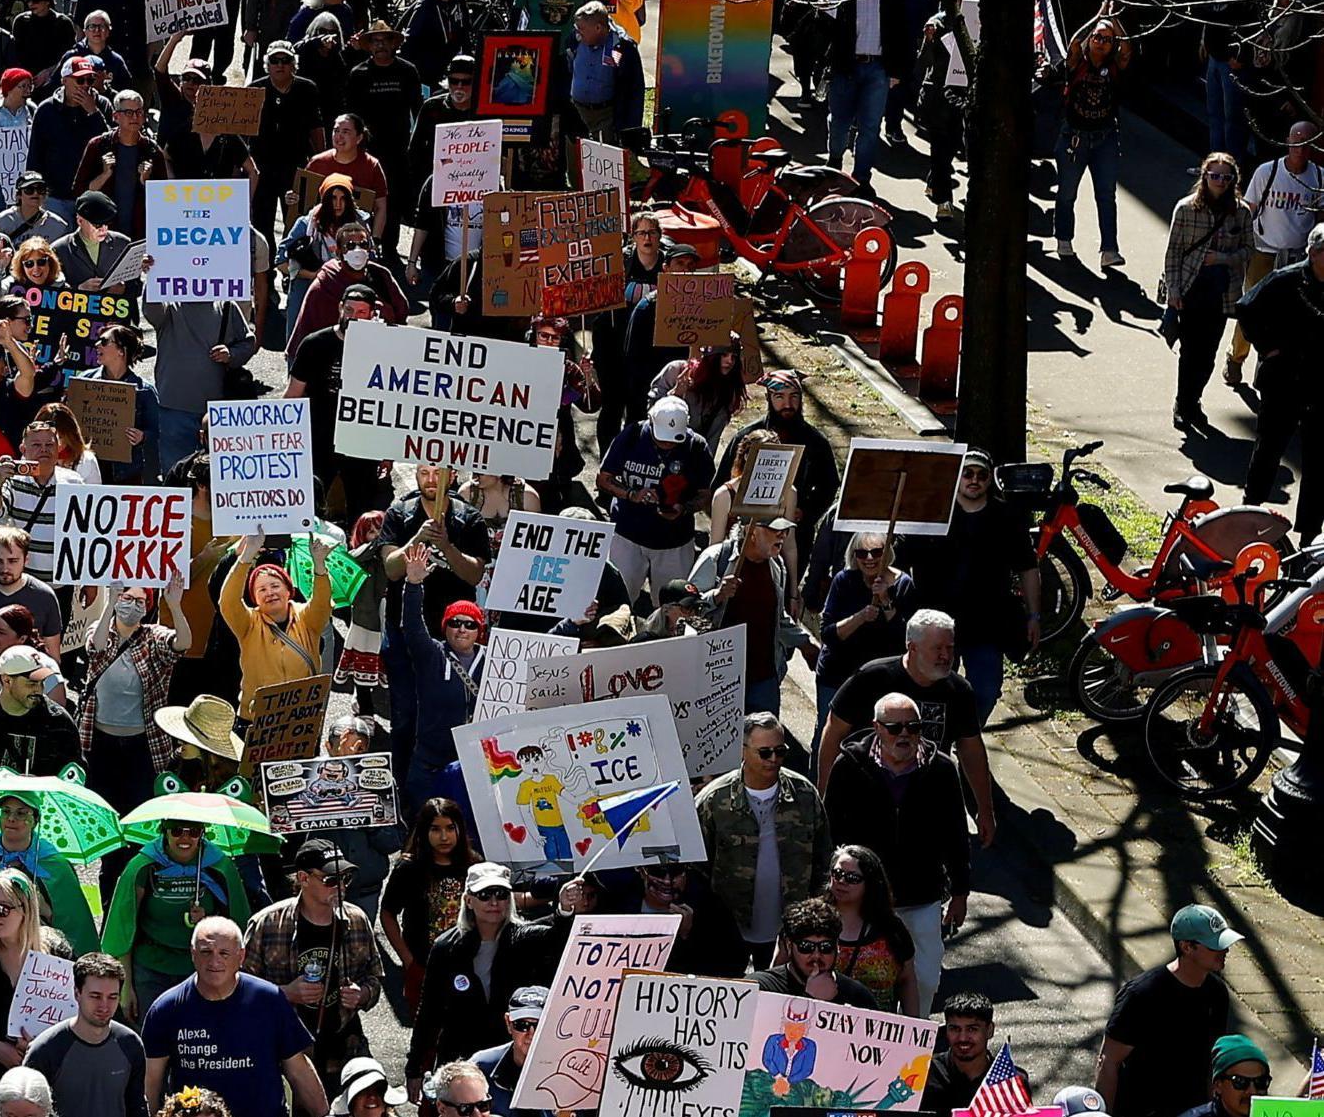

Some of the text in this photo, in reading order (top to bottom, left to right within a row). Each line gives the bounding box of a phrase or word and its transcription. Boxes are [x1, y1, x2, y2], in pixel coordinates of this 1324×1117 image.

[707, 3, 726, 83] BIKETOWN
[165, 185, 232, 203] STOP
[183, 210, 211, 219] THE
[157, 225, 242, 246] DECAY
[192, 256, 209, 267] OF
[157, 276, 244, 298] TRUTH
[424, 336, 486, 368] END
[367, 364, 529, 410] AMERICAN
[209, 403, 303, 428] DEMOCRACY
[338, 394, 554, 450] BELLIGERENCE
[214, 433, 305, 451] DOESN'T FEAR
[404, 434, 490, 471] NOW!!
[221, 453, 303, 480] PROTEST
[758, 457, 788, 468] LIBERTY
[754, 471, 785, 482] JUSTICE
[216, 490, 305, 508] DICTATORS DO
[752, 486, 776, 499] ALL
[63, 495, 185, 539] NO ICE
[55, 537, 182, 580] NO KKK
[635, 981, 752, 1018] HISTORY
[674, 1017, 716, 1046] HAS
[720, 1043, 748, 1070] ITS
